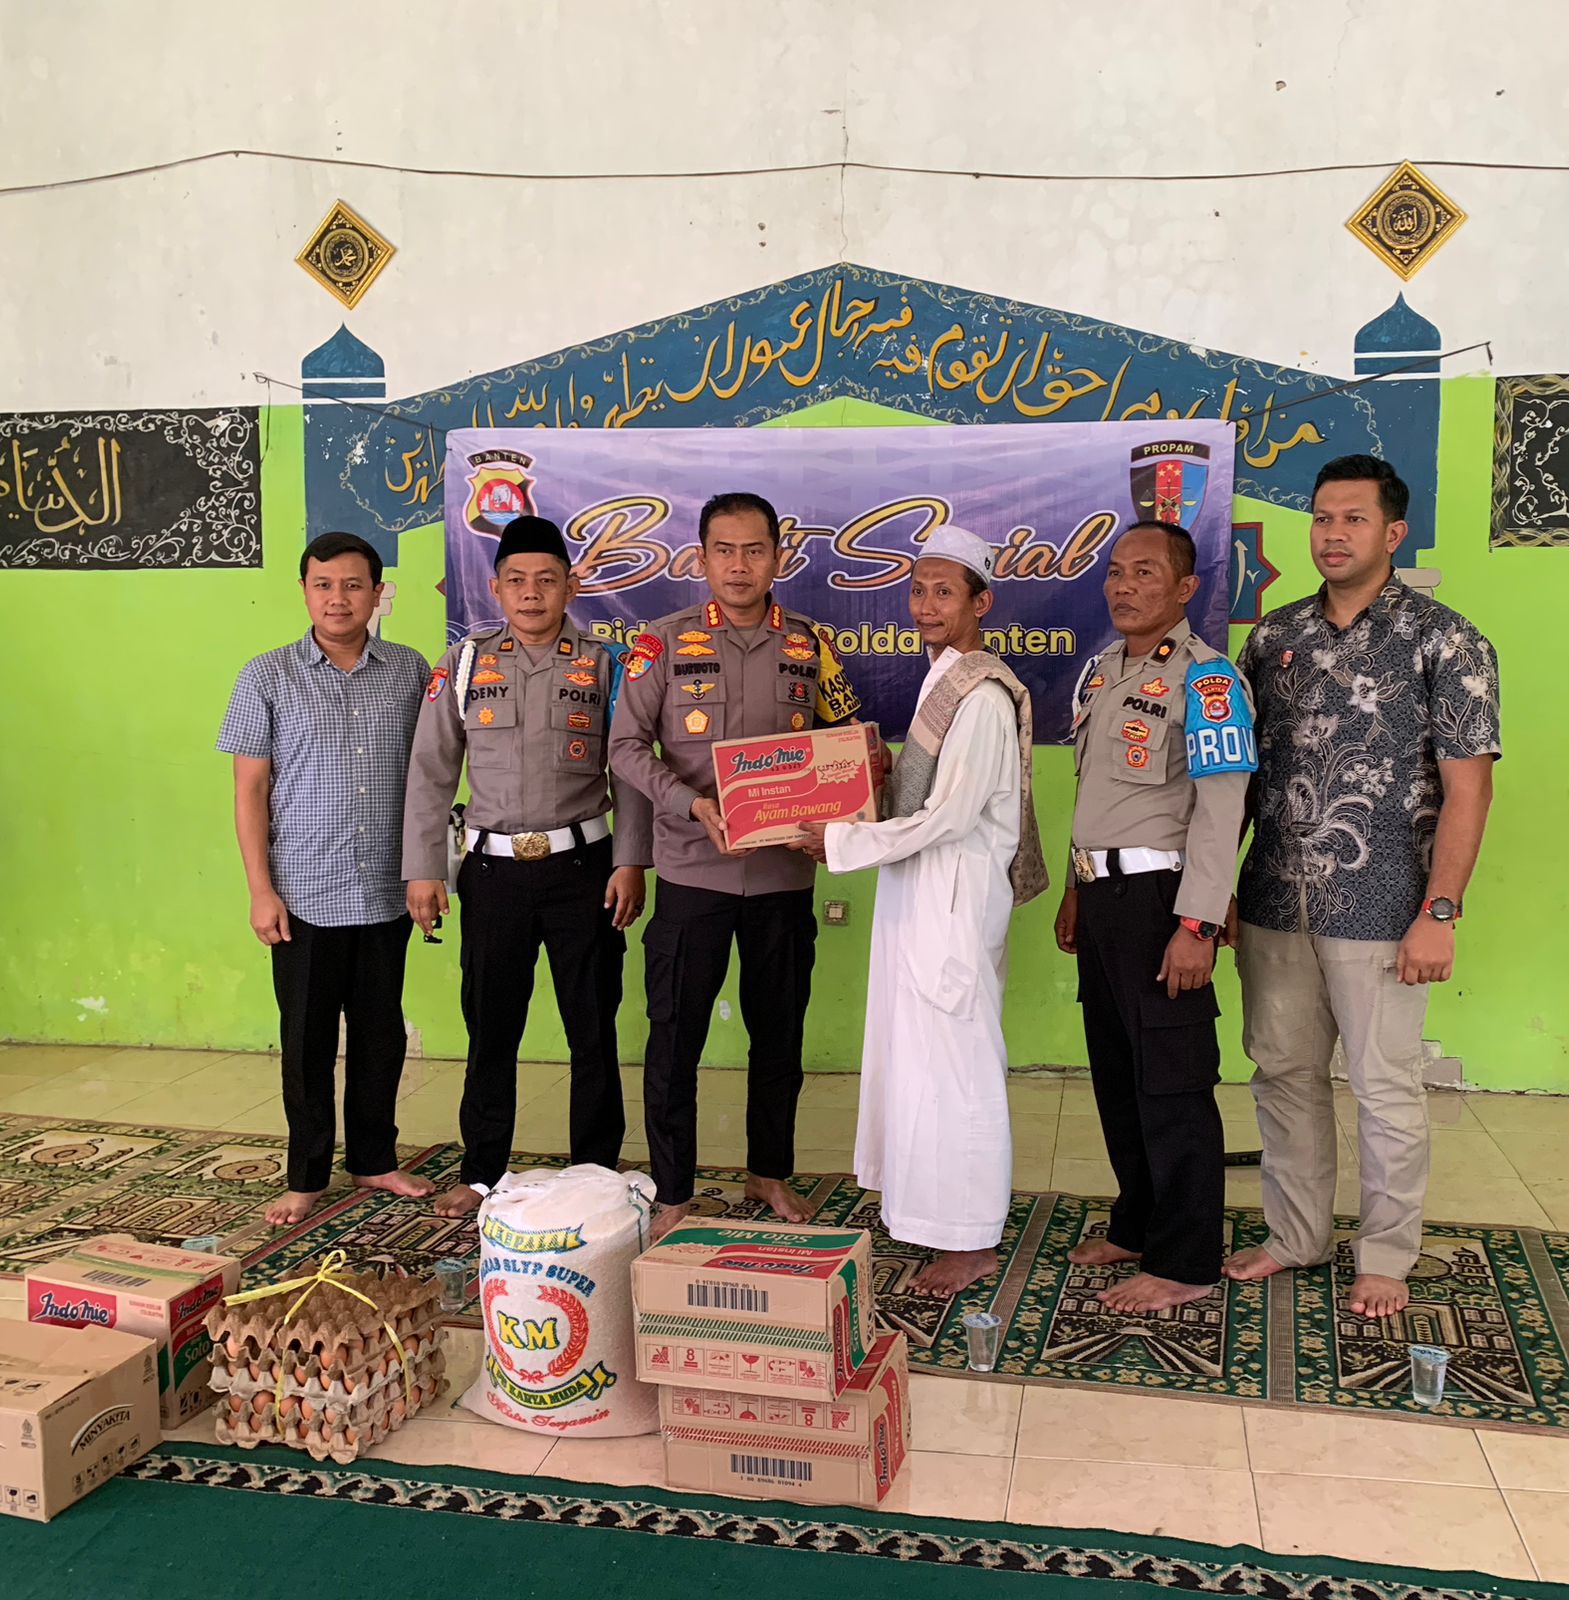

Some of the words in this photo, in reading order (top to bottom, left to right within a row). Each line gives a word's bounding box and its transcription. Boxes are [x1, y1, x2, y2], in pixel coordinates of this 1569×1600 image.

[1143, 443, 1195, 456] PROPAM
[474, 453, 528, 466] BANTEN
[564, 495, 835, 597] Bati
[779, 663, 817, 679] POLRI
[1197, 677, 1229, 688] POLDA
[471, 686, 509, 700] DENY
[559, 688, 600, 705] POLRI
[1122, 696, 1168, 718] POLRI
[748, 787, 760, 798] Mi
[761, 785, 791, 798] Instan
[753, 808, 788, 824] Ayam
[791, 801, 842, 820] Bawang
[503, 1259, 543, 1276] SLYP
[546, 1264, 596, 1298] SUPER
[497, 1311, 560, 1350] KM
[686, 1348, 695, 1361] 8
[549, 1381, 588, 1405] MUDA
[79, 1410, 131, 1451] MINYAKITA
